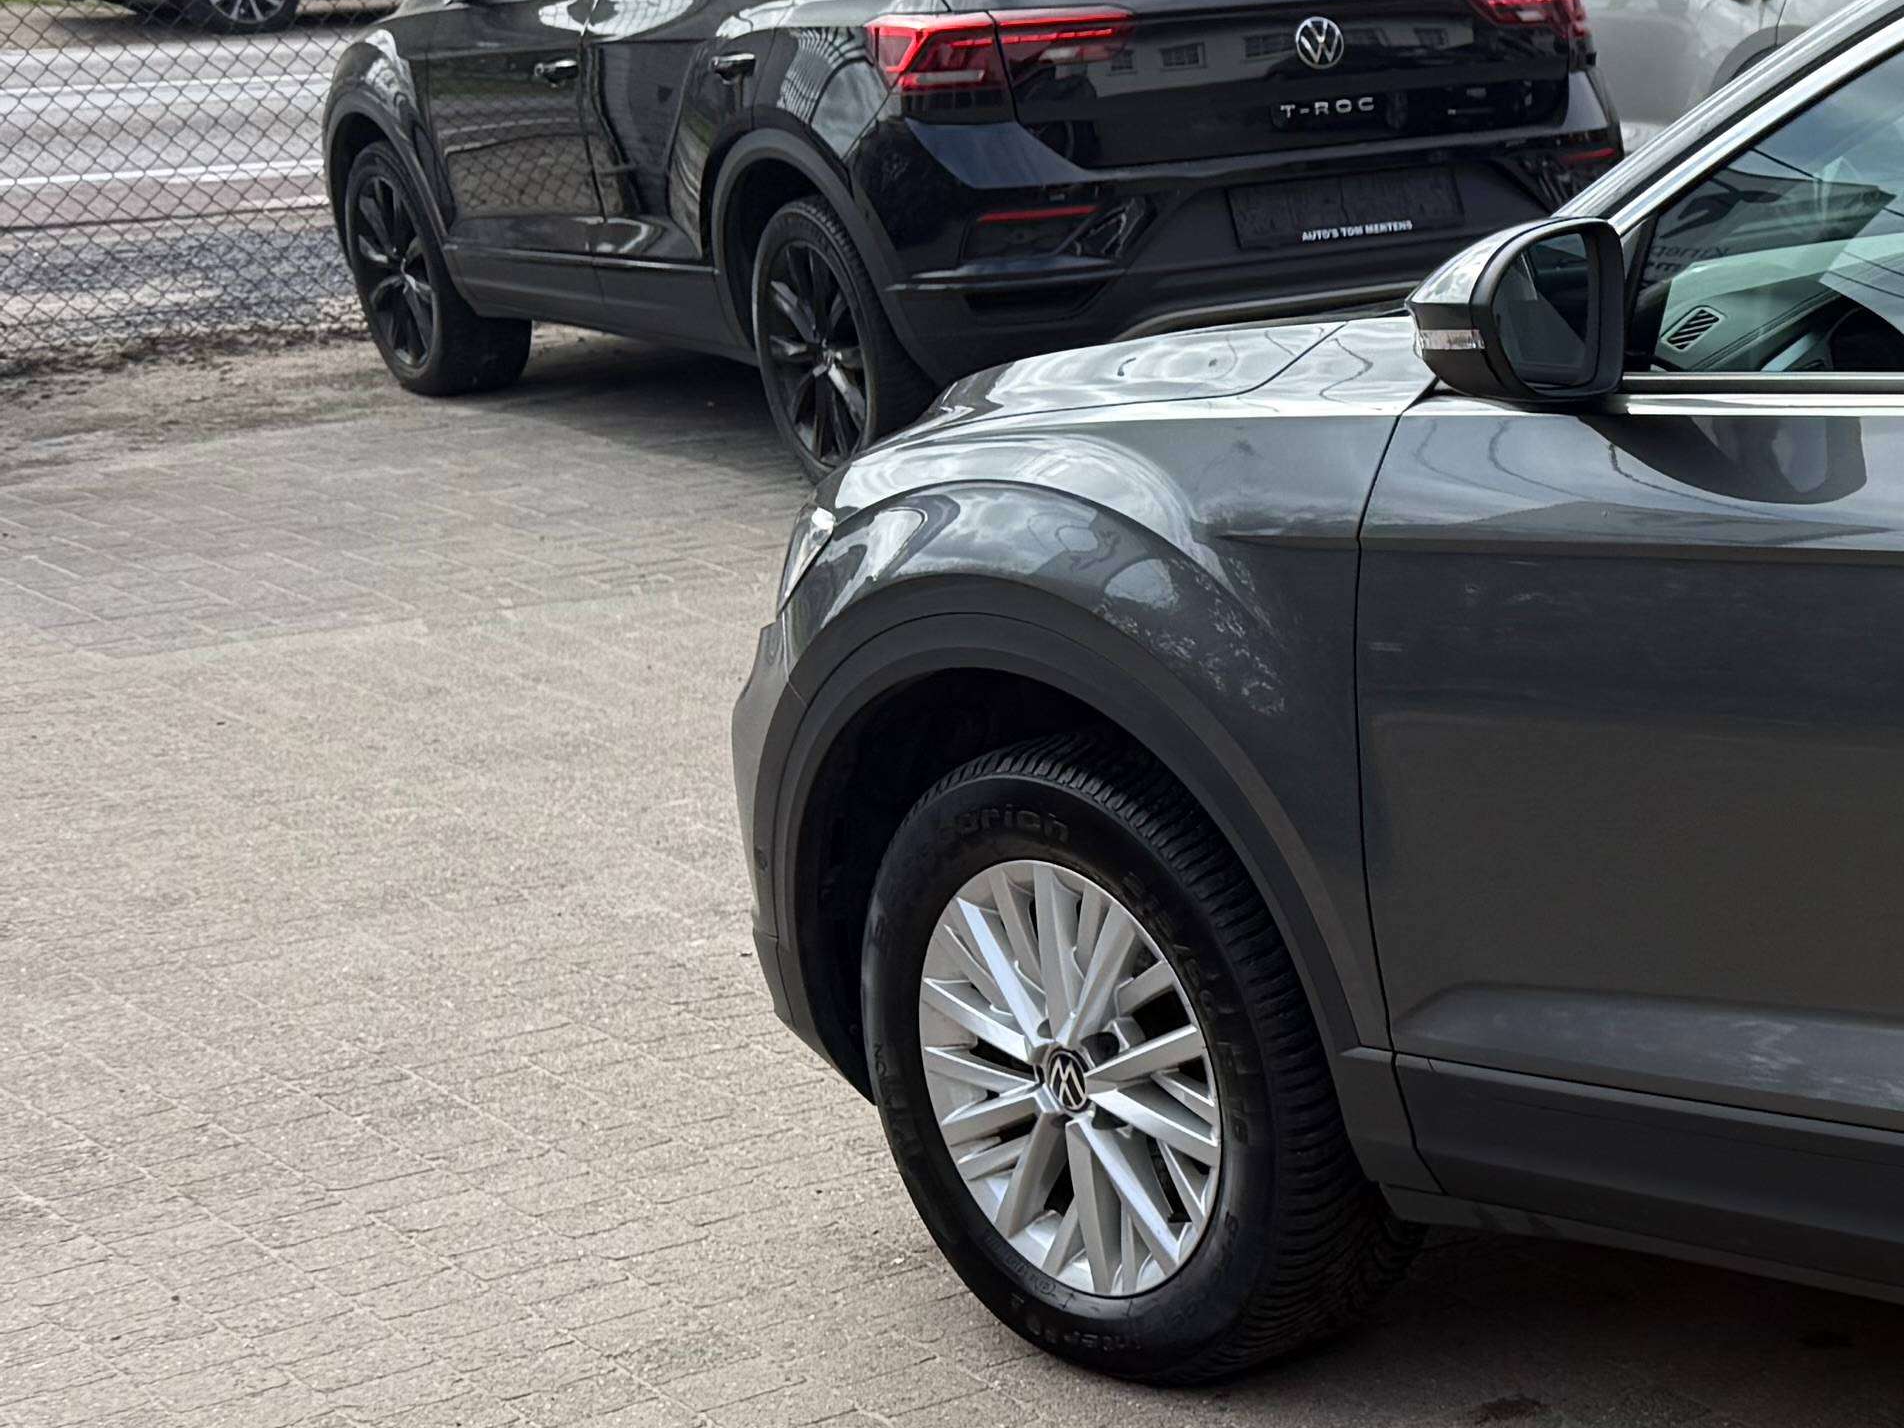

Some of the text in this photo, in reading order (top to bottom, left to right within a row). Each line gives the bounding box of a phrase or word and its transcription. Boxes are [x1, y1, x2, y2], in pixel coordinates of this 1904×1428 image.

[1280, 97, 1374, 118] T-ROC
[1340, 225, 1363, 236] TOM
[1365, 220, 1412, 234] MERTENS
